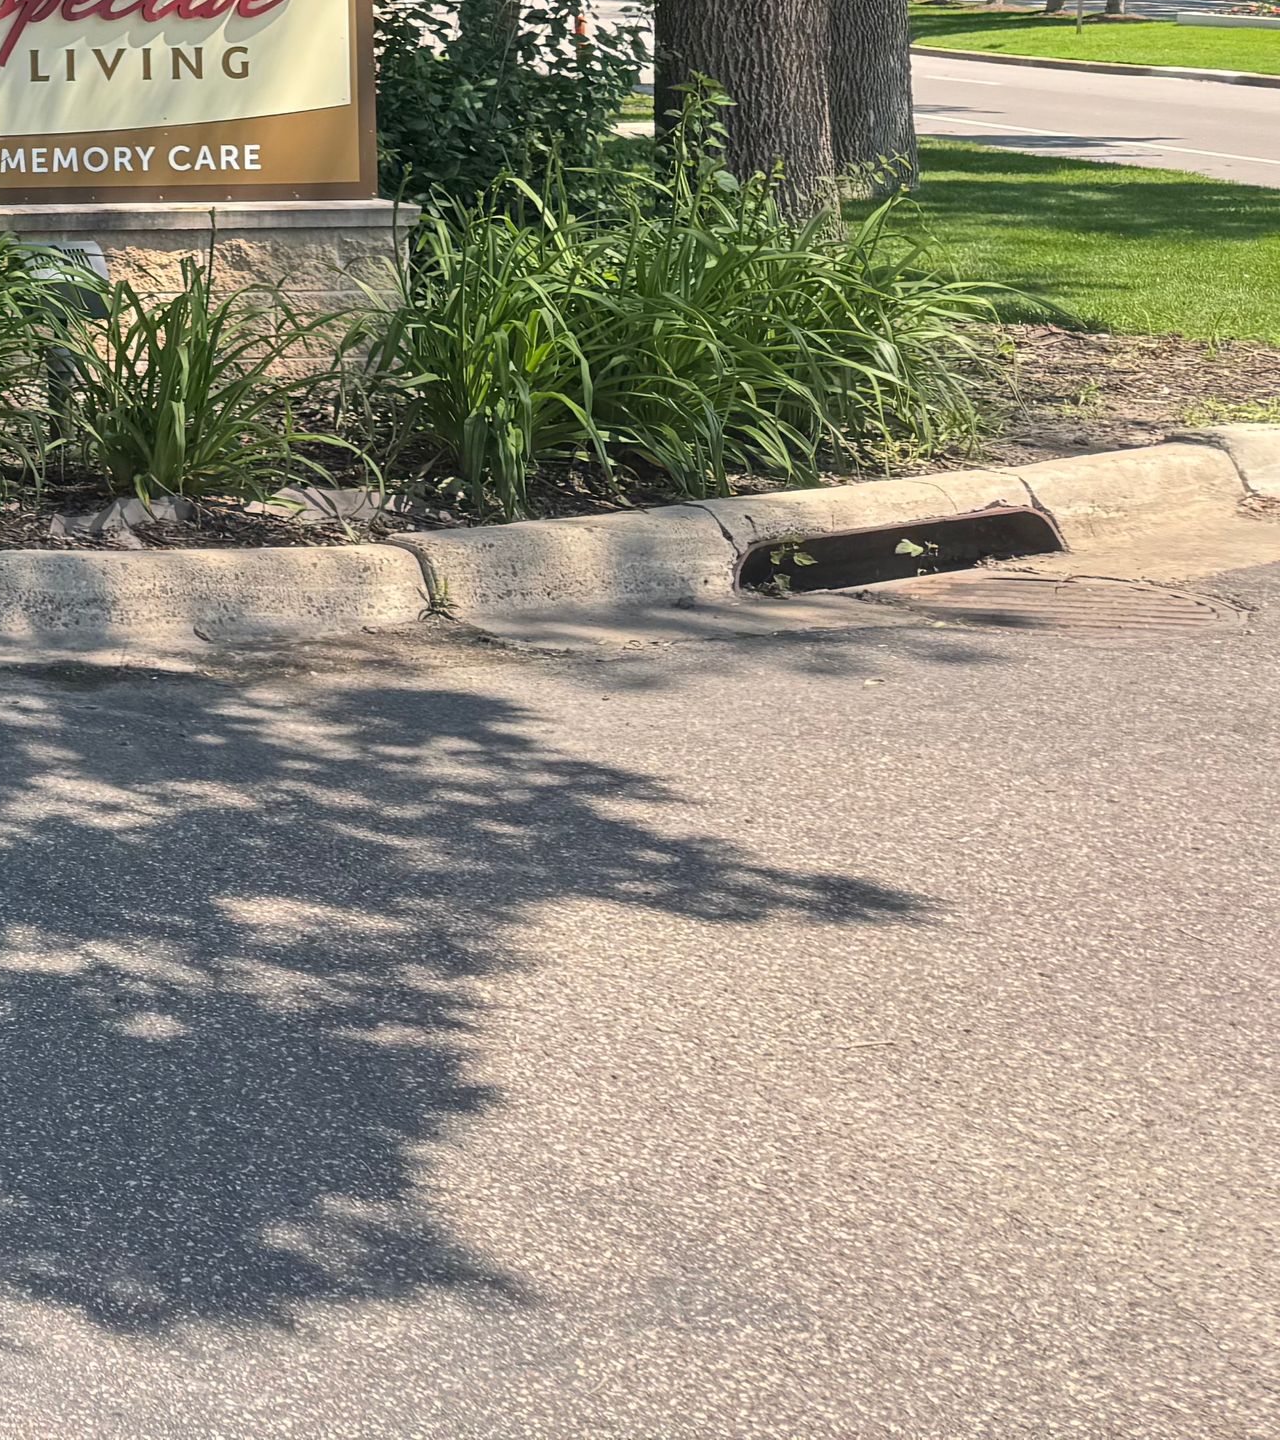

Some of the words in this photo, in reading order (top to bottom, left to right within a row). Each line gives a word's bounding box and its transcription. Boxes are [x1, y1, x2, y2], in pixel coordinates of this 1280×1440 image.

[28, 46, 250, 82] LIVING
[0, 146, 155, 173] MEMORY
[168, 144, 262, 171] CARE
